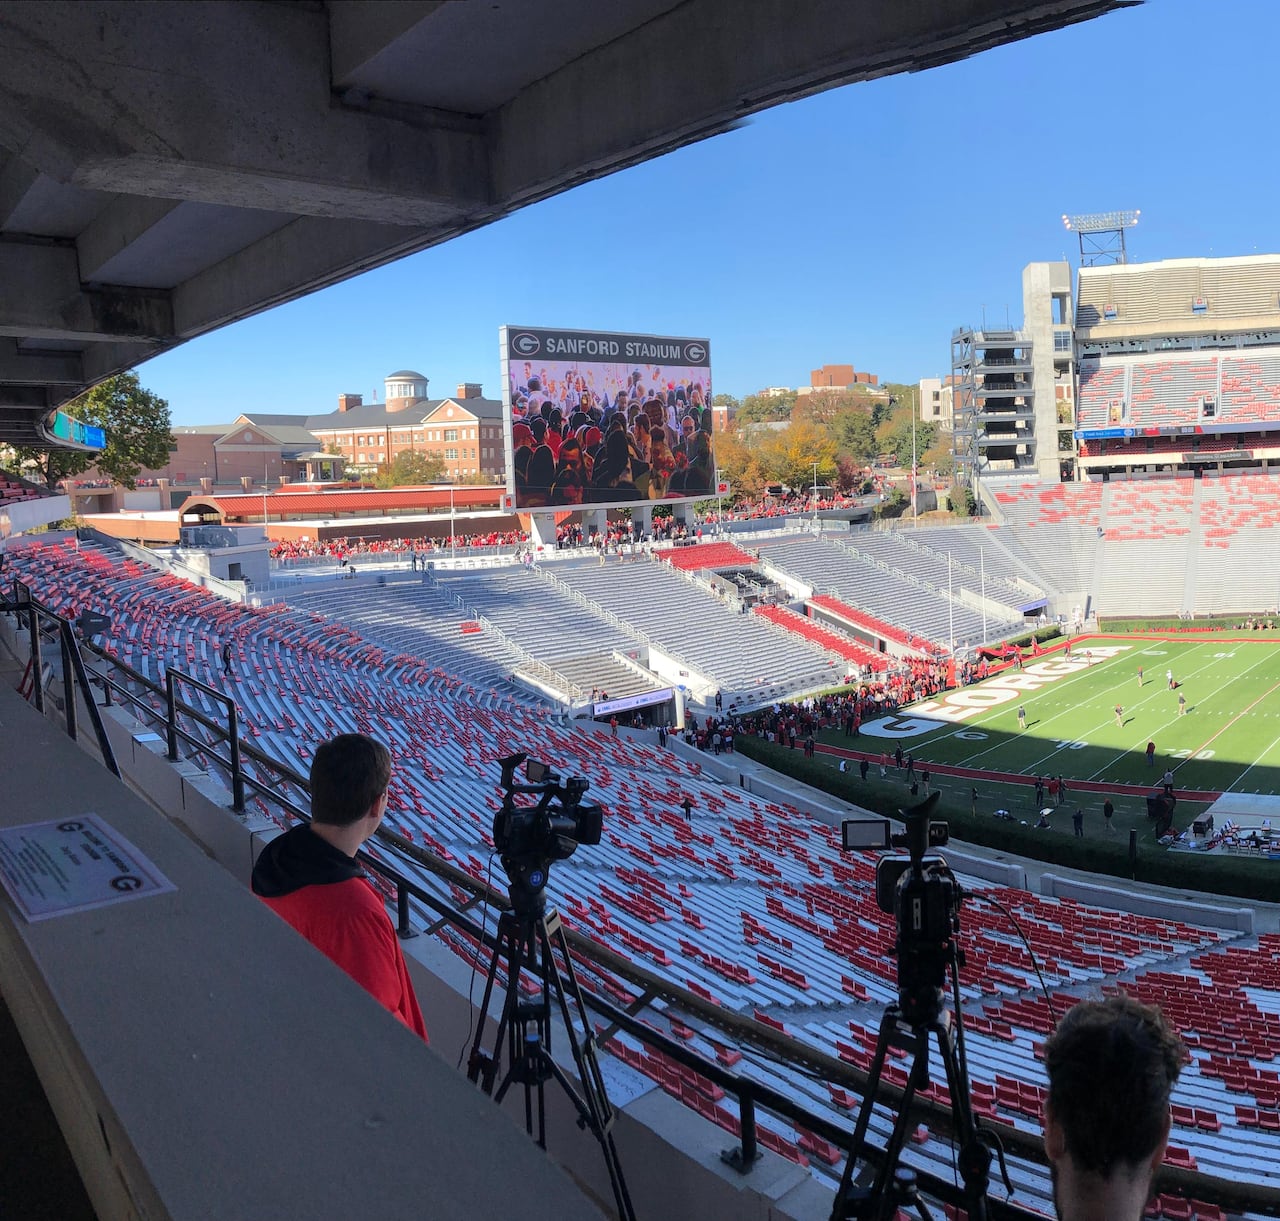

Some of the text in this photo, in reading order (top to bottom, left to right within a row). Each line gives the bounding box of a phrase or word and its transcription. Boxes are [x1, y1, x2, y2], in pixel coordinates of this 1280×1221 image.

[546, 338, 619, 356] SANFORD
[626, 342, 680, 359] STADIUM
[859, 645, 1135, 738] GEORGIA
[1172, 749, 1216, 759] 20
